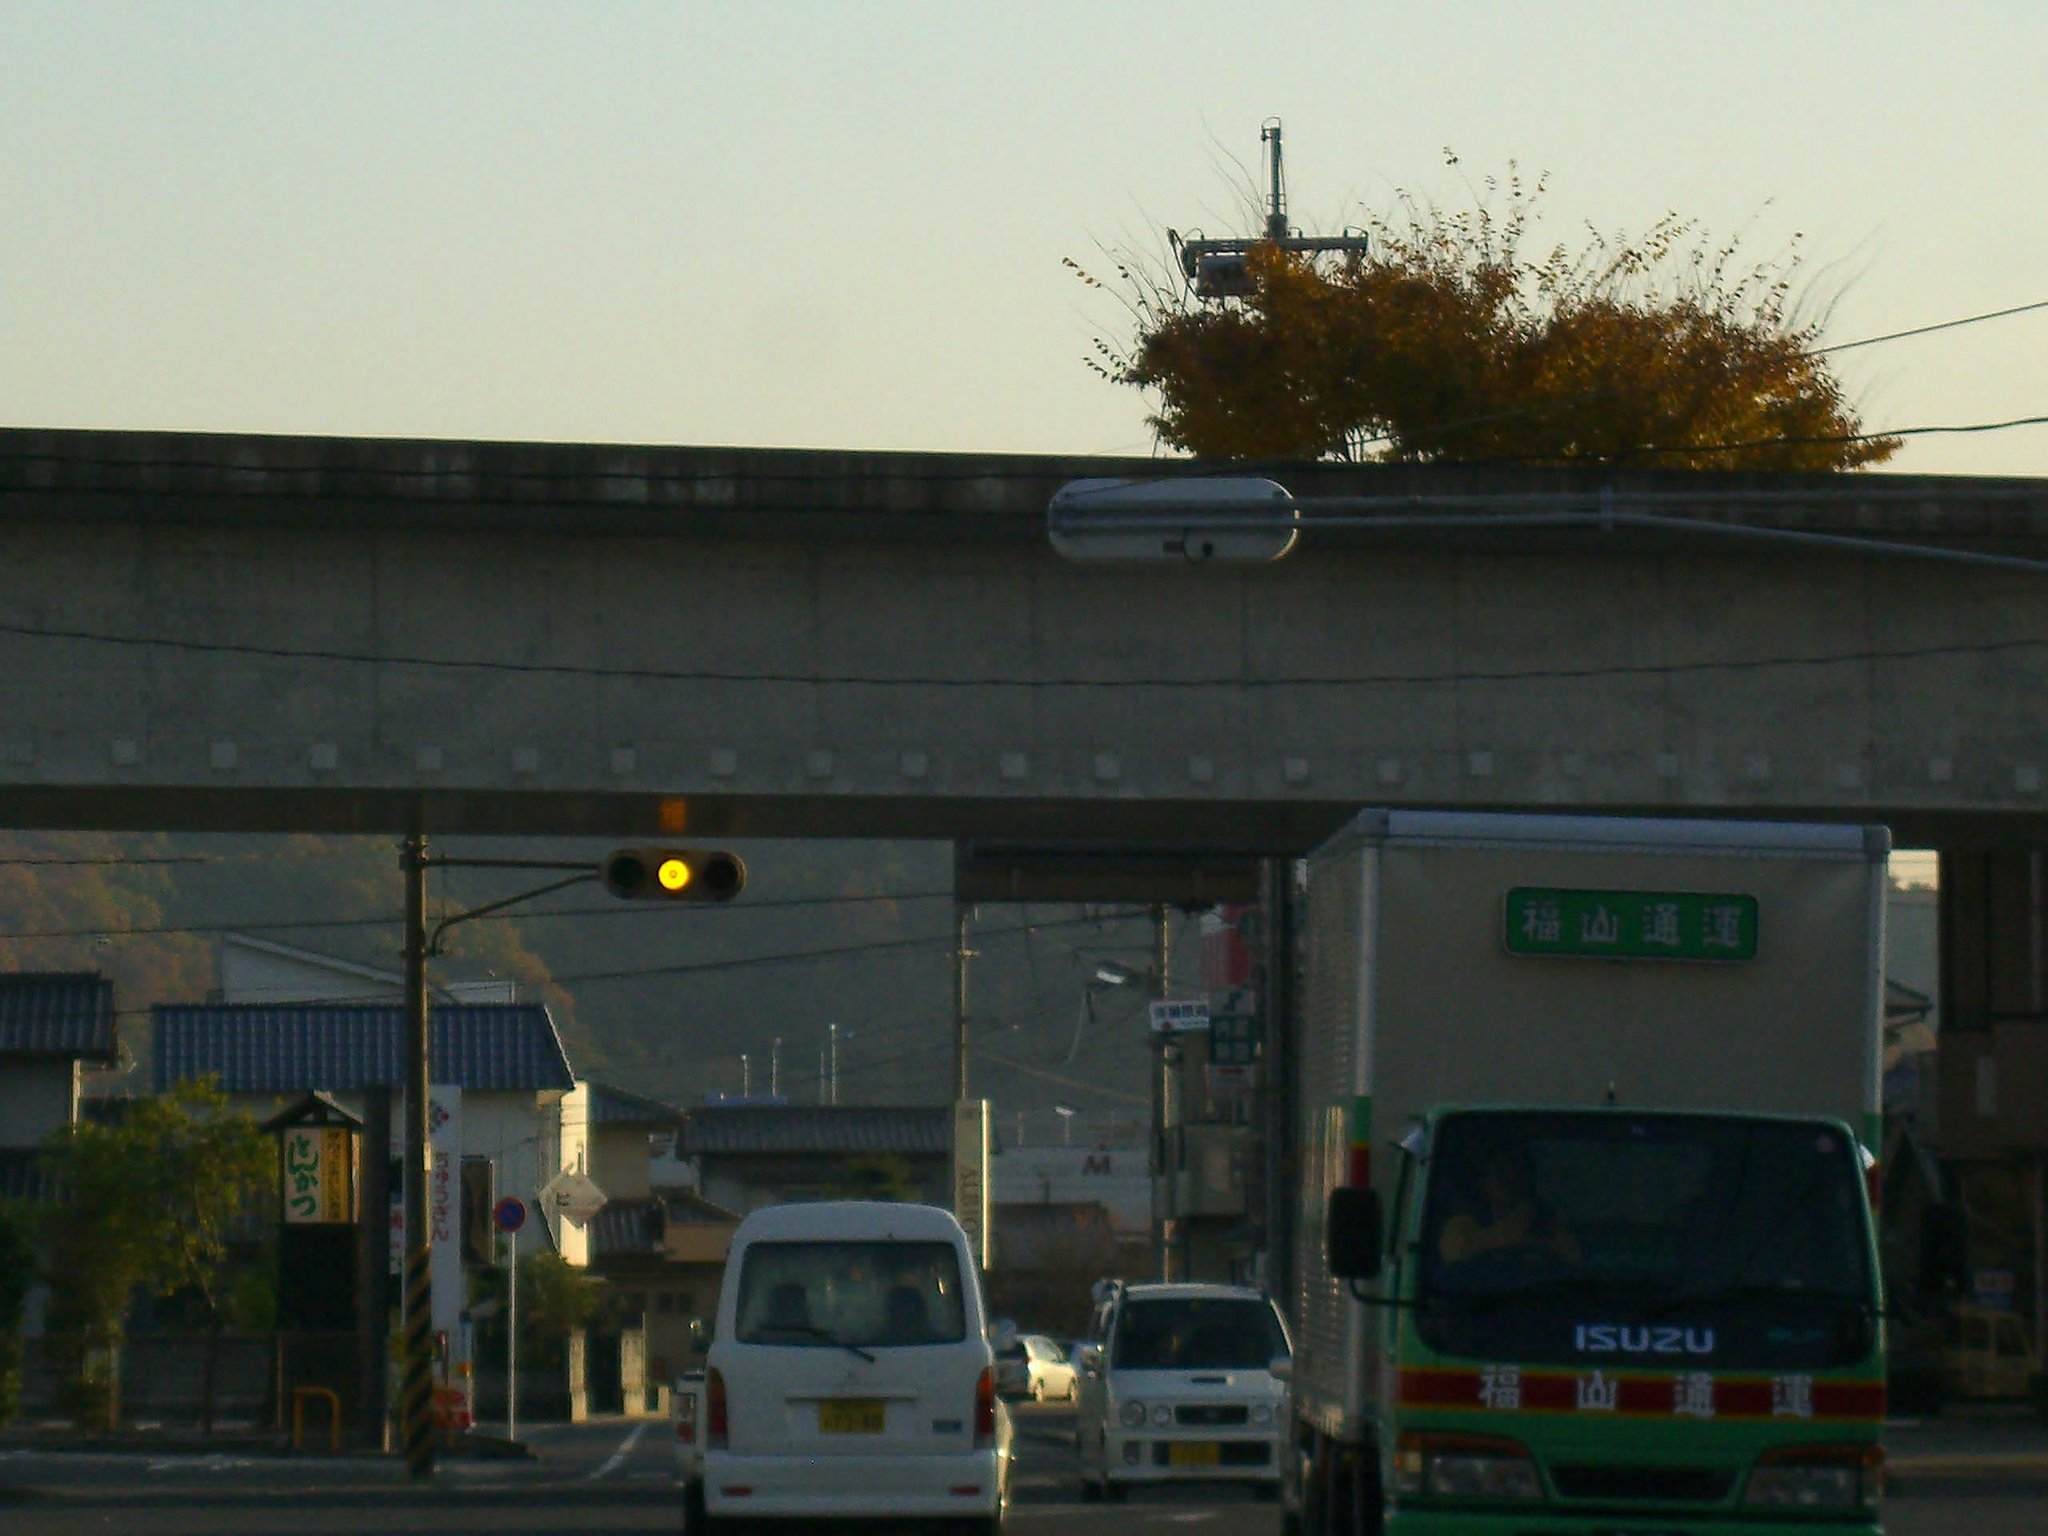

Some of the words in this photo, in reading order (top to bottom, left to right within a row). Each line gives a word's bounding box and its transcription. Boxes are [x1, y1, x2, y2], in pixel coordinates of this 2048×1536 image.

[1522, 901, 1743, 948] 福山通運
[1575, 1324, 1714, 1354] ISUZU
[1478, 1364, 1814, 1419] 福山通運
